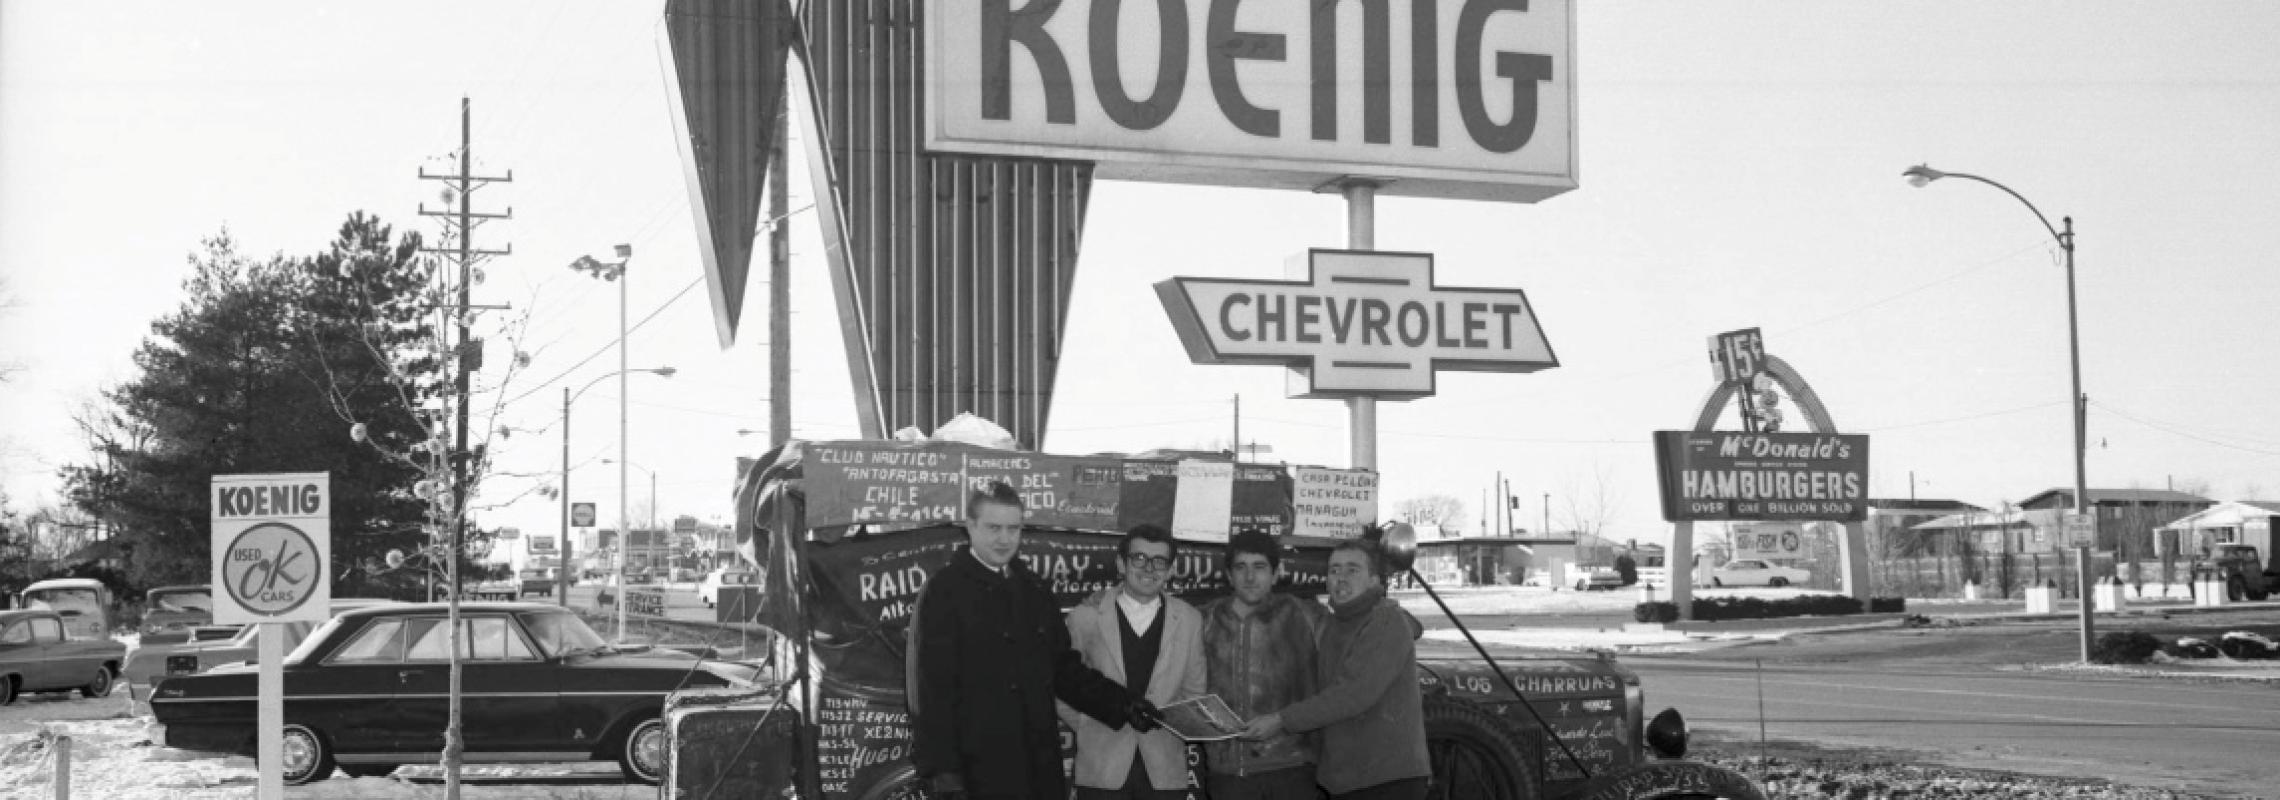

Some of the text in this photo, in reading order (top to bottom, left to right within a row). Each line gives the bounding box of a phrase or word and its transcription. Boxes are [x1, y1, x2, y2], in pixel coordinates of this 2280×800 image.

[1219, 291, 1521, 351] CHEVROLET
[1719, 436, 1851, 460] McDonald's
[865, 485, 919, 506] CHILE
[1682, 470, 1860, 500] HAMBURGERS
[218, 484, 321, 518] KOENIG
[1691, 502, 1853, 514] OVER ONE BILLION SOLD
[234, 547, 262, 562] USED
[859, 565, 928, 602] RAID
[260, 590, 294, 602] CARS
[1454, 675, 1493, 694] LOS
[849, 745, 902, 769] HUGO
